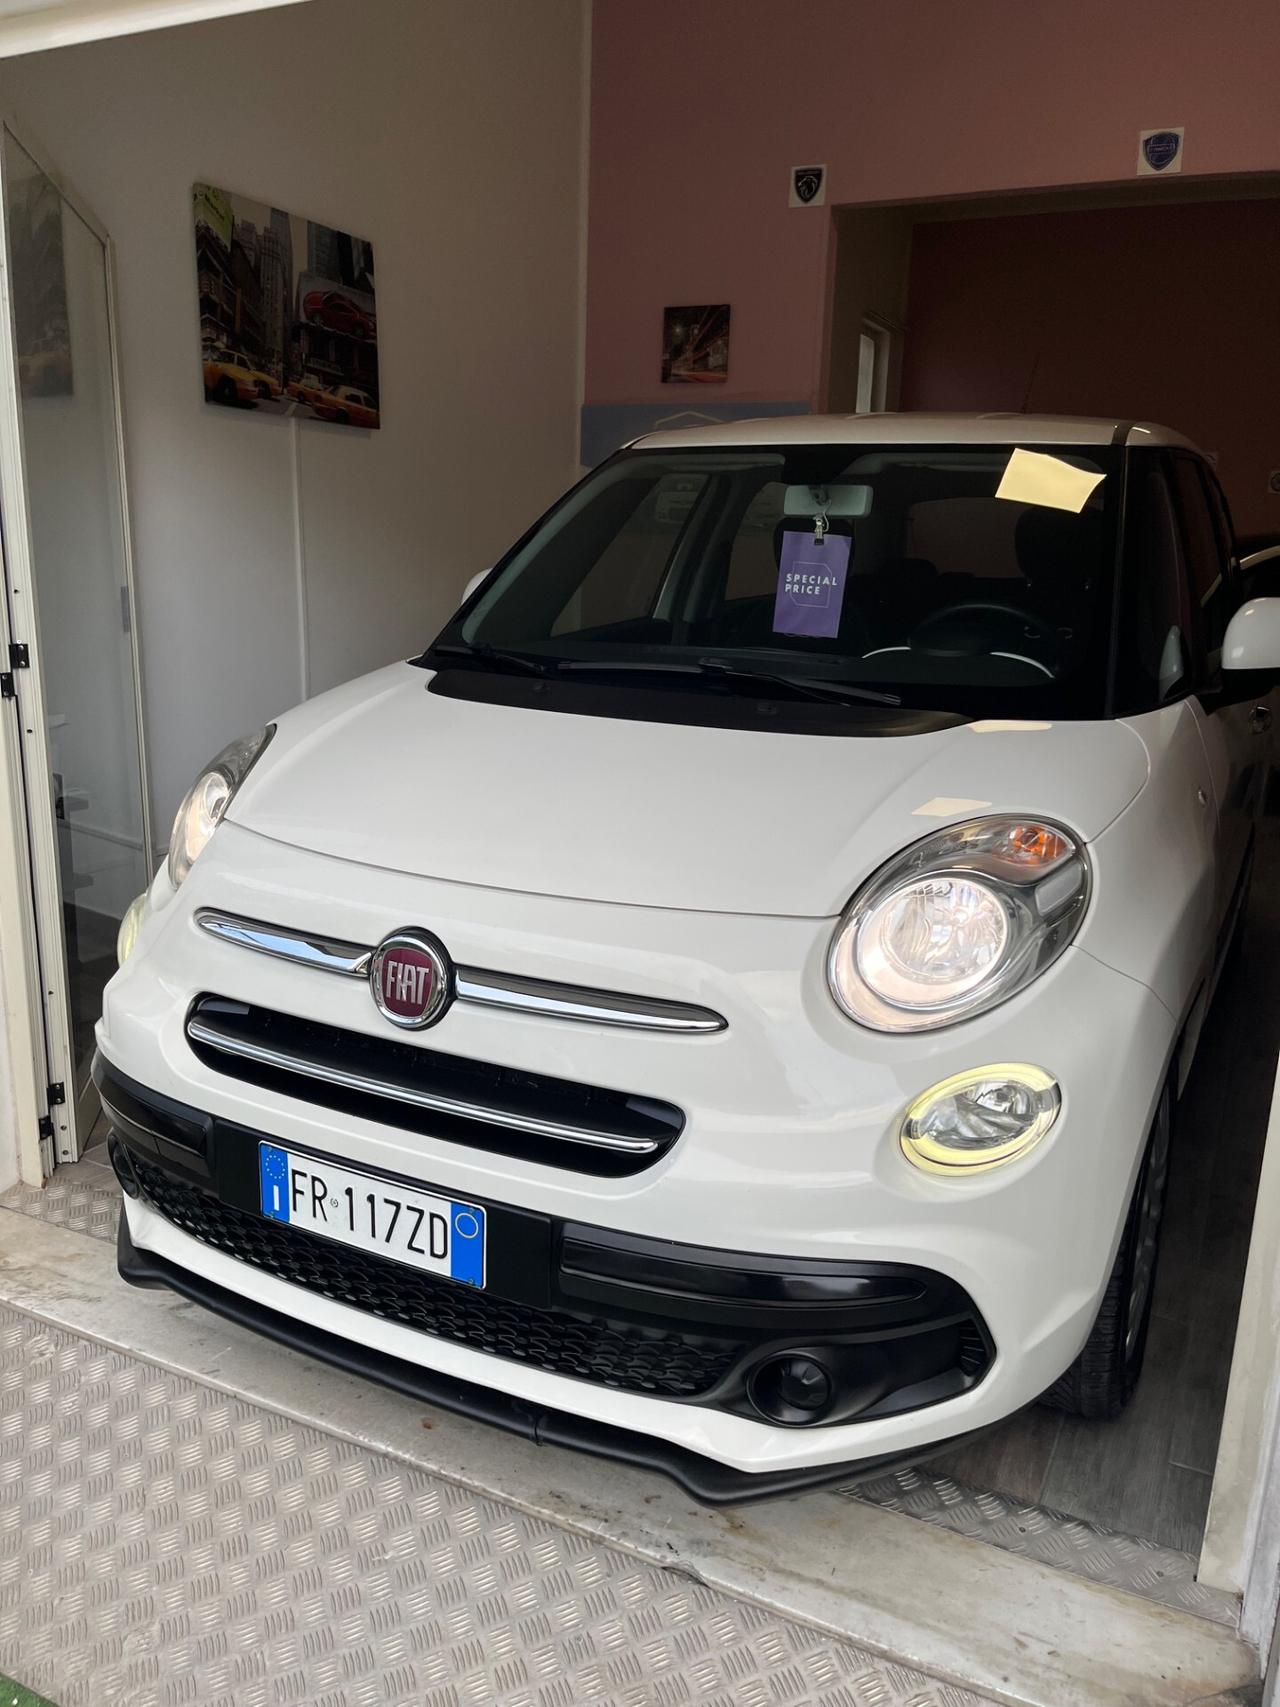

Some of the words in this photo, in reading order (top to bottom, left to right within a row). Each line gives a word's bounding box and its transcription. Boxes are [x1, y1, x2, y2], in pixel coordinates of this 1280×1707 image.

[786, 573, 838, 586] SPECIAL
[785, 584, 821, 595] PRICE
[386, 960, 430, 1005] FIAT
